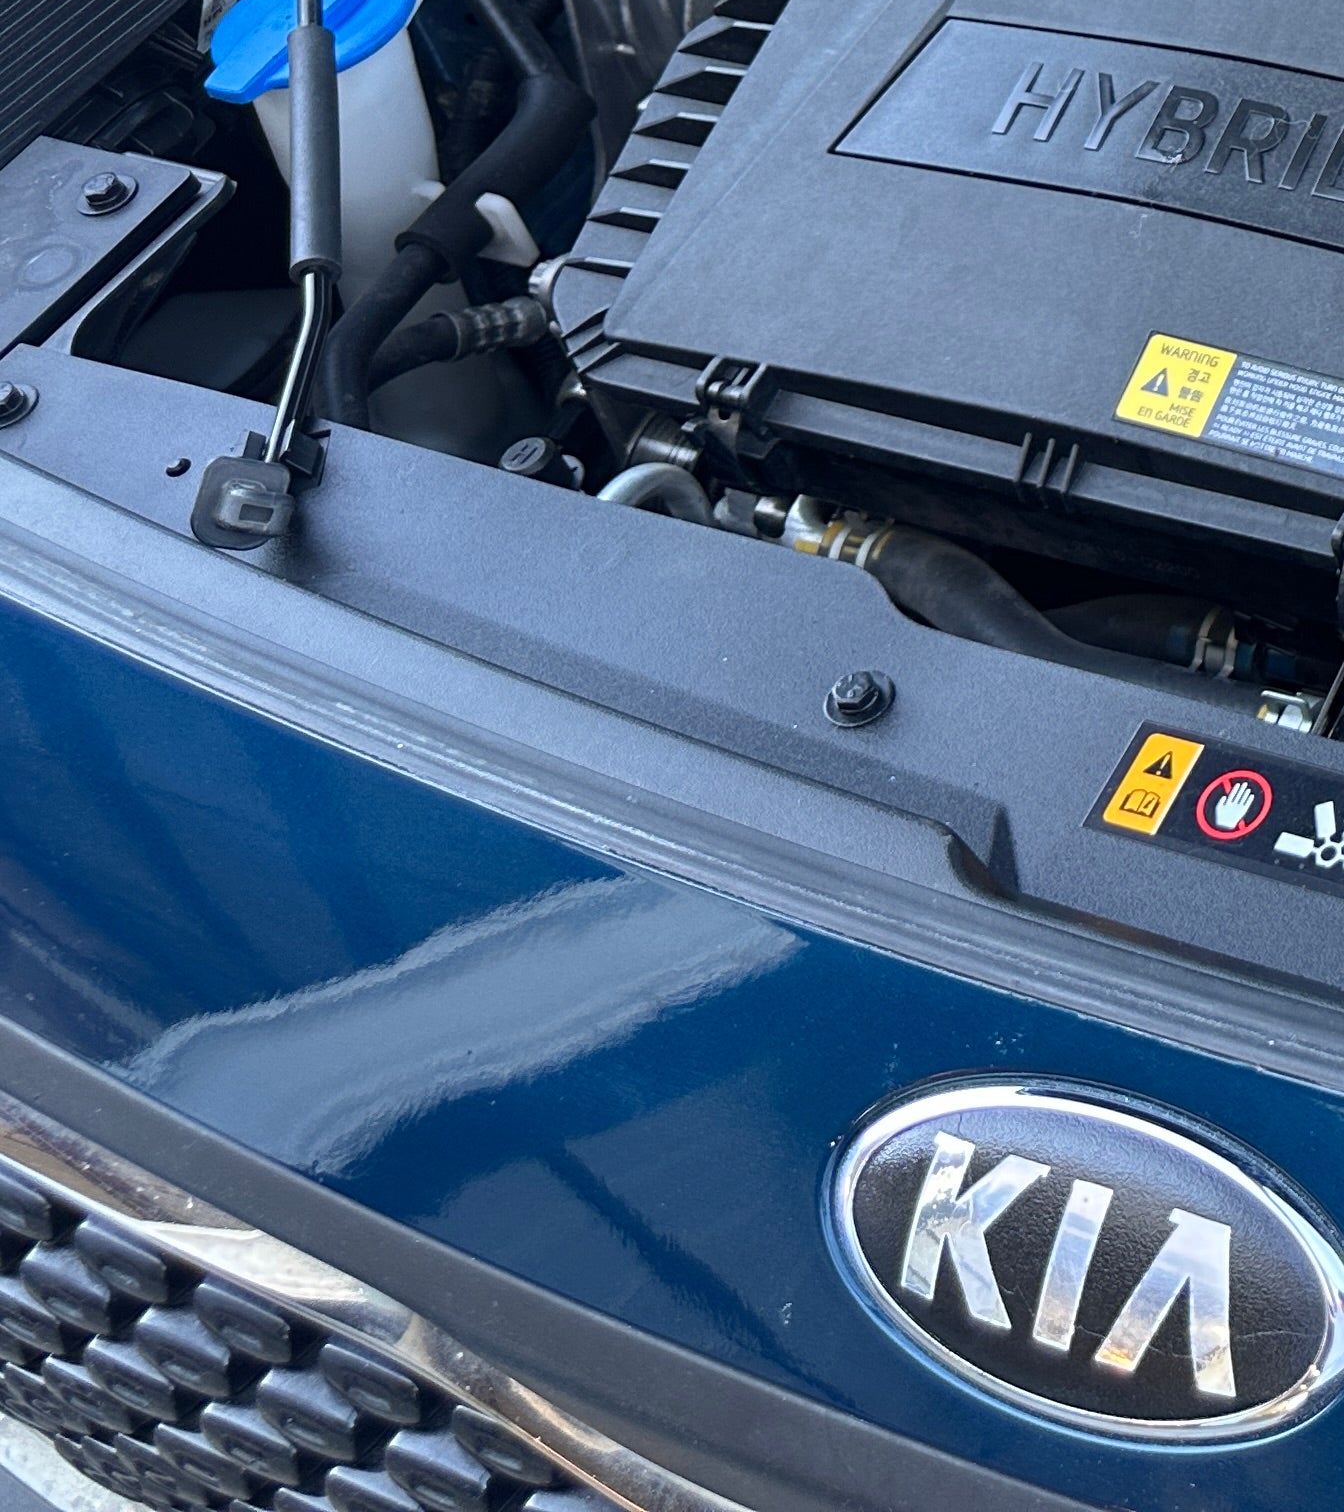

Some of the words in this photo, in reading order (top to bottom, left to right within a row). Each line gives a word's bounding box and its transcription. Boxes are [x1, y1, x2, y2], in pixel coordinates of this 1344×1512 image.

[1160, 343, 1220, 368] WARNING
[1186, 368, 1212, 384] 경고
[1154, 408, 1192, 428] GARDE
[1169, 403, 1197, 418] MISE
[899, 1131, 1238, 1400] KIA
